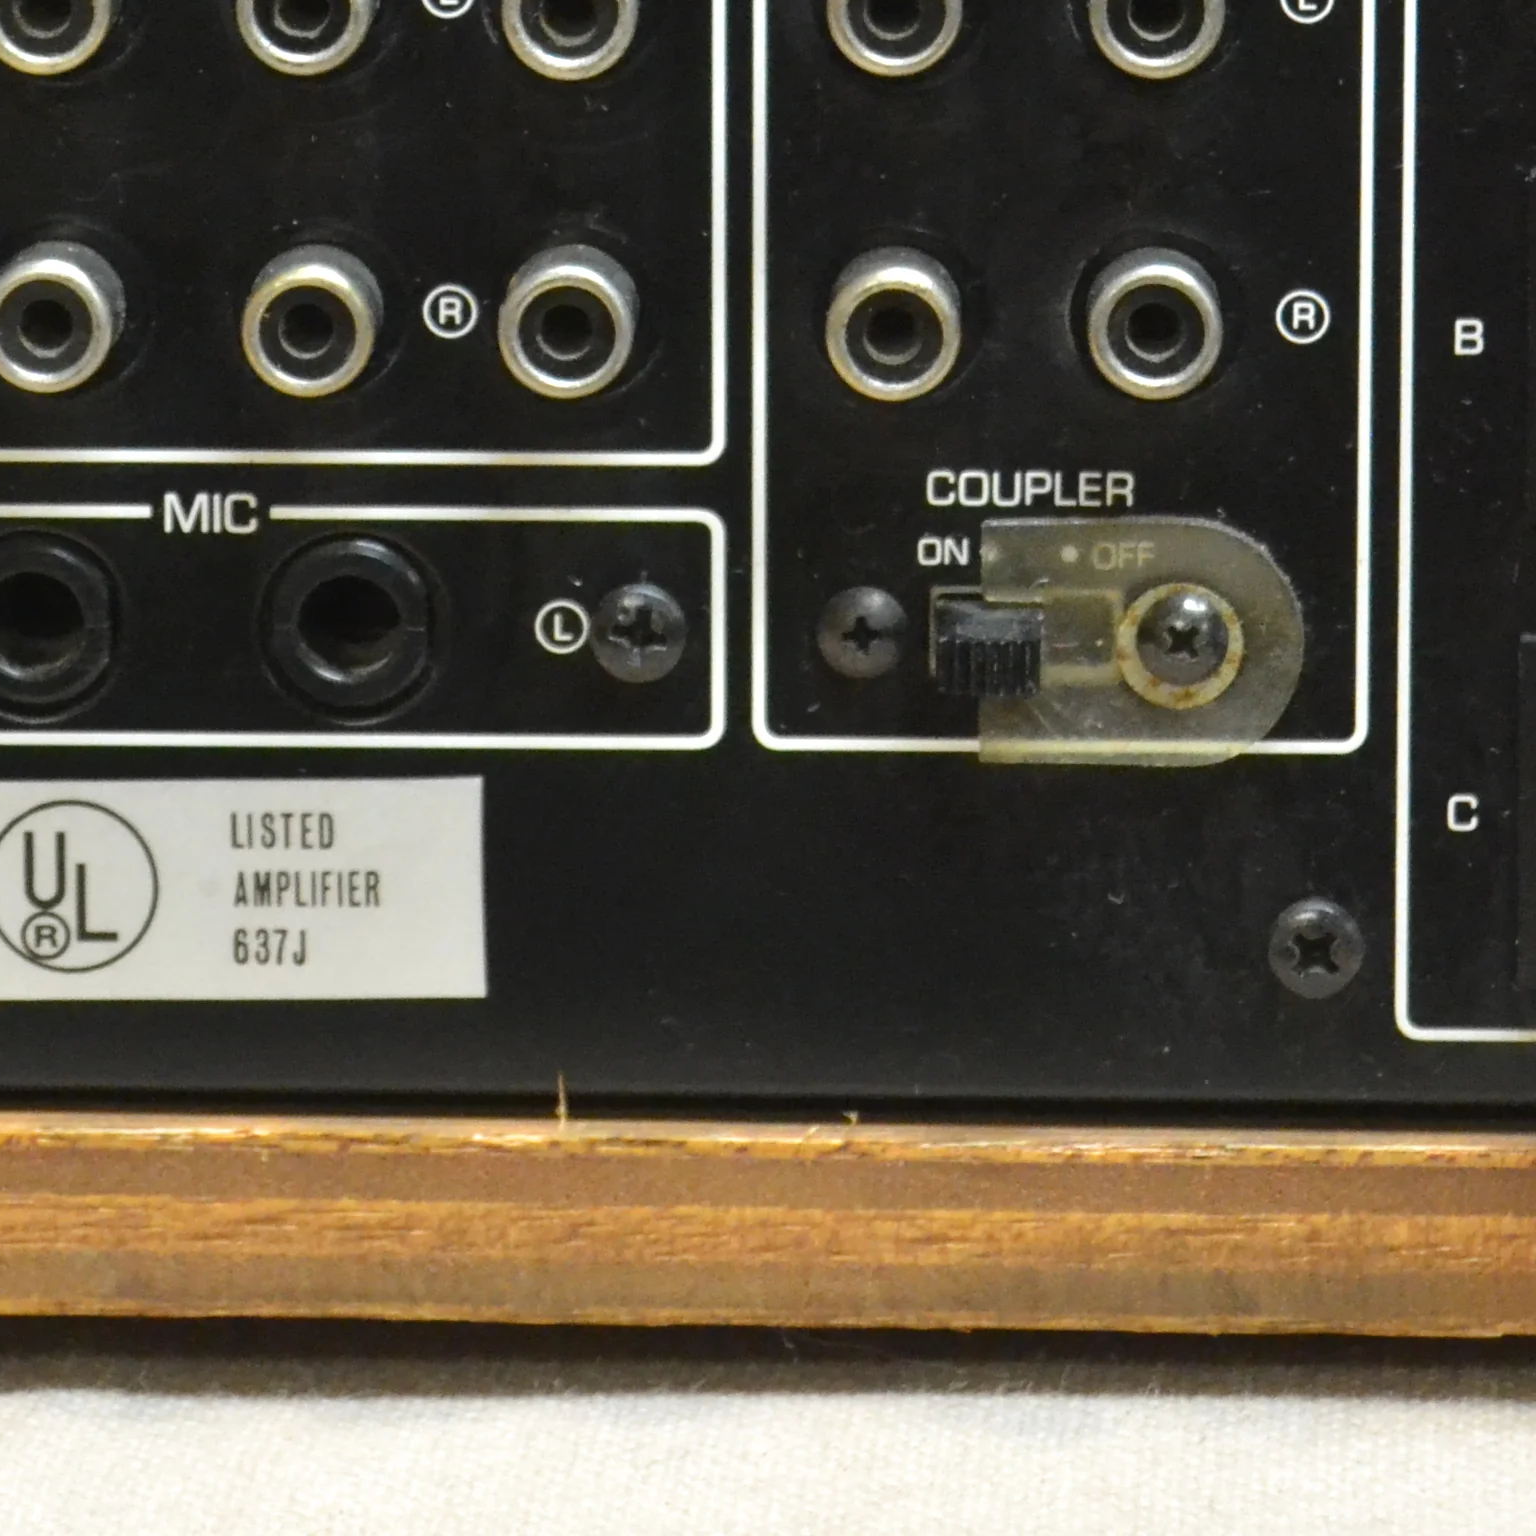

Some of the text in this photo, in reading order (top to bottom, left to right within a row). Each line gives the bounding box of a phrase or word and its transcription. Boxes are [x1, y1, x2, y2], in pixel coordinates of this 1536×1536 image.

[1455, 319, 1486, 357] B
[927, 470, 1135, 509] COUPLER
[164, 492, 259, 535] MIC
[918, 537, 971, 567] ON
[1092, 541, 1156, 572] OFF
[231, 813, 336, 851] LISTED
[1447, 794, 1480, 833] C
[235, 871, 381, 909] AMPLIFIER
[234, 928, 308, 968] 637J
